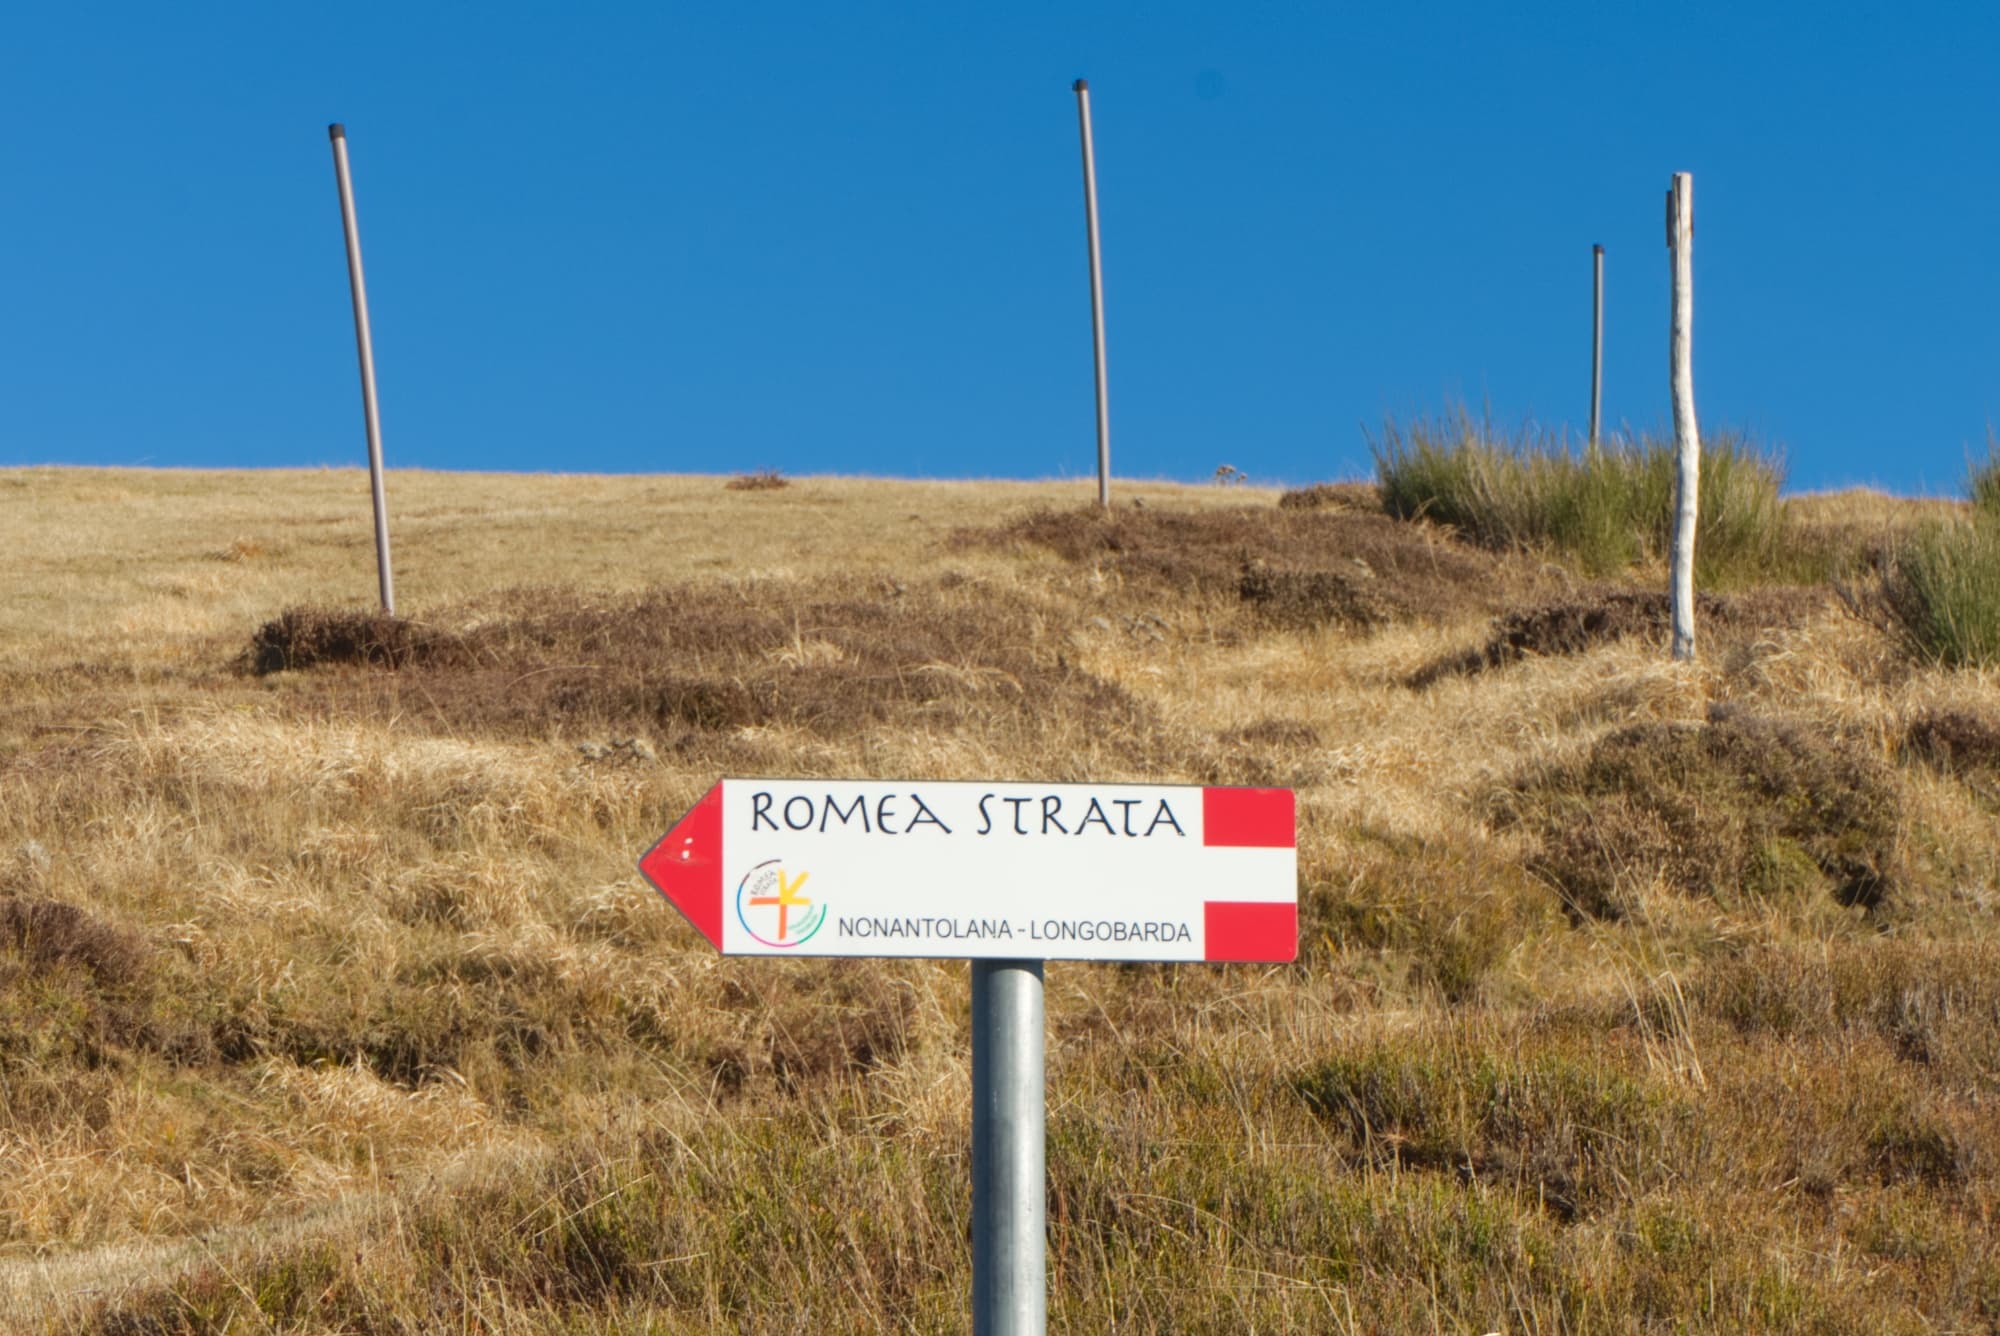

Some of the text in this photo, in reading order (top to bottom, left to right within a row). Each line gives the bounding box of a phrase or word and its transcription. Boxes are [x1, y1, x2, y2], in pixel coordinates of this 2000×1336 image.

[751, 791, 1186, 838] ROMEA STRATA
[839, 917, 1013, 940] NONANTOLANA
[1031, 919, 1192, 943] LONGOBARDA
